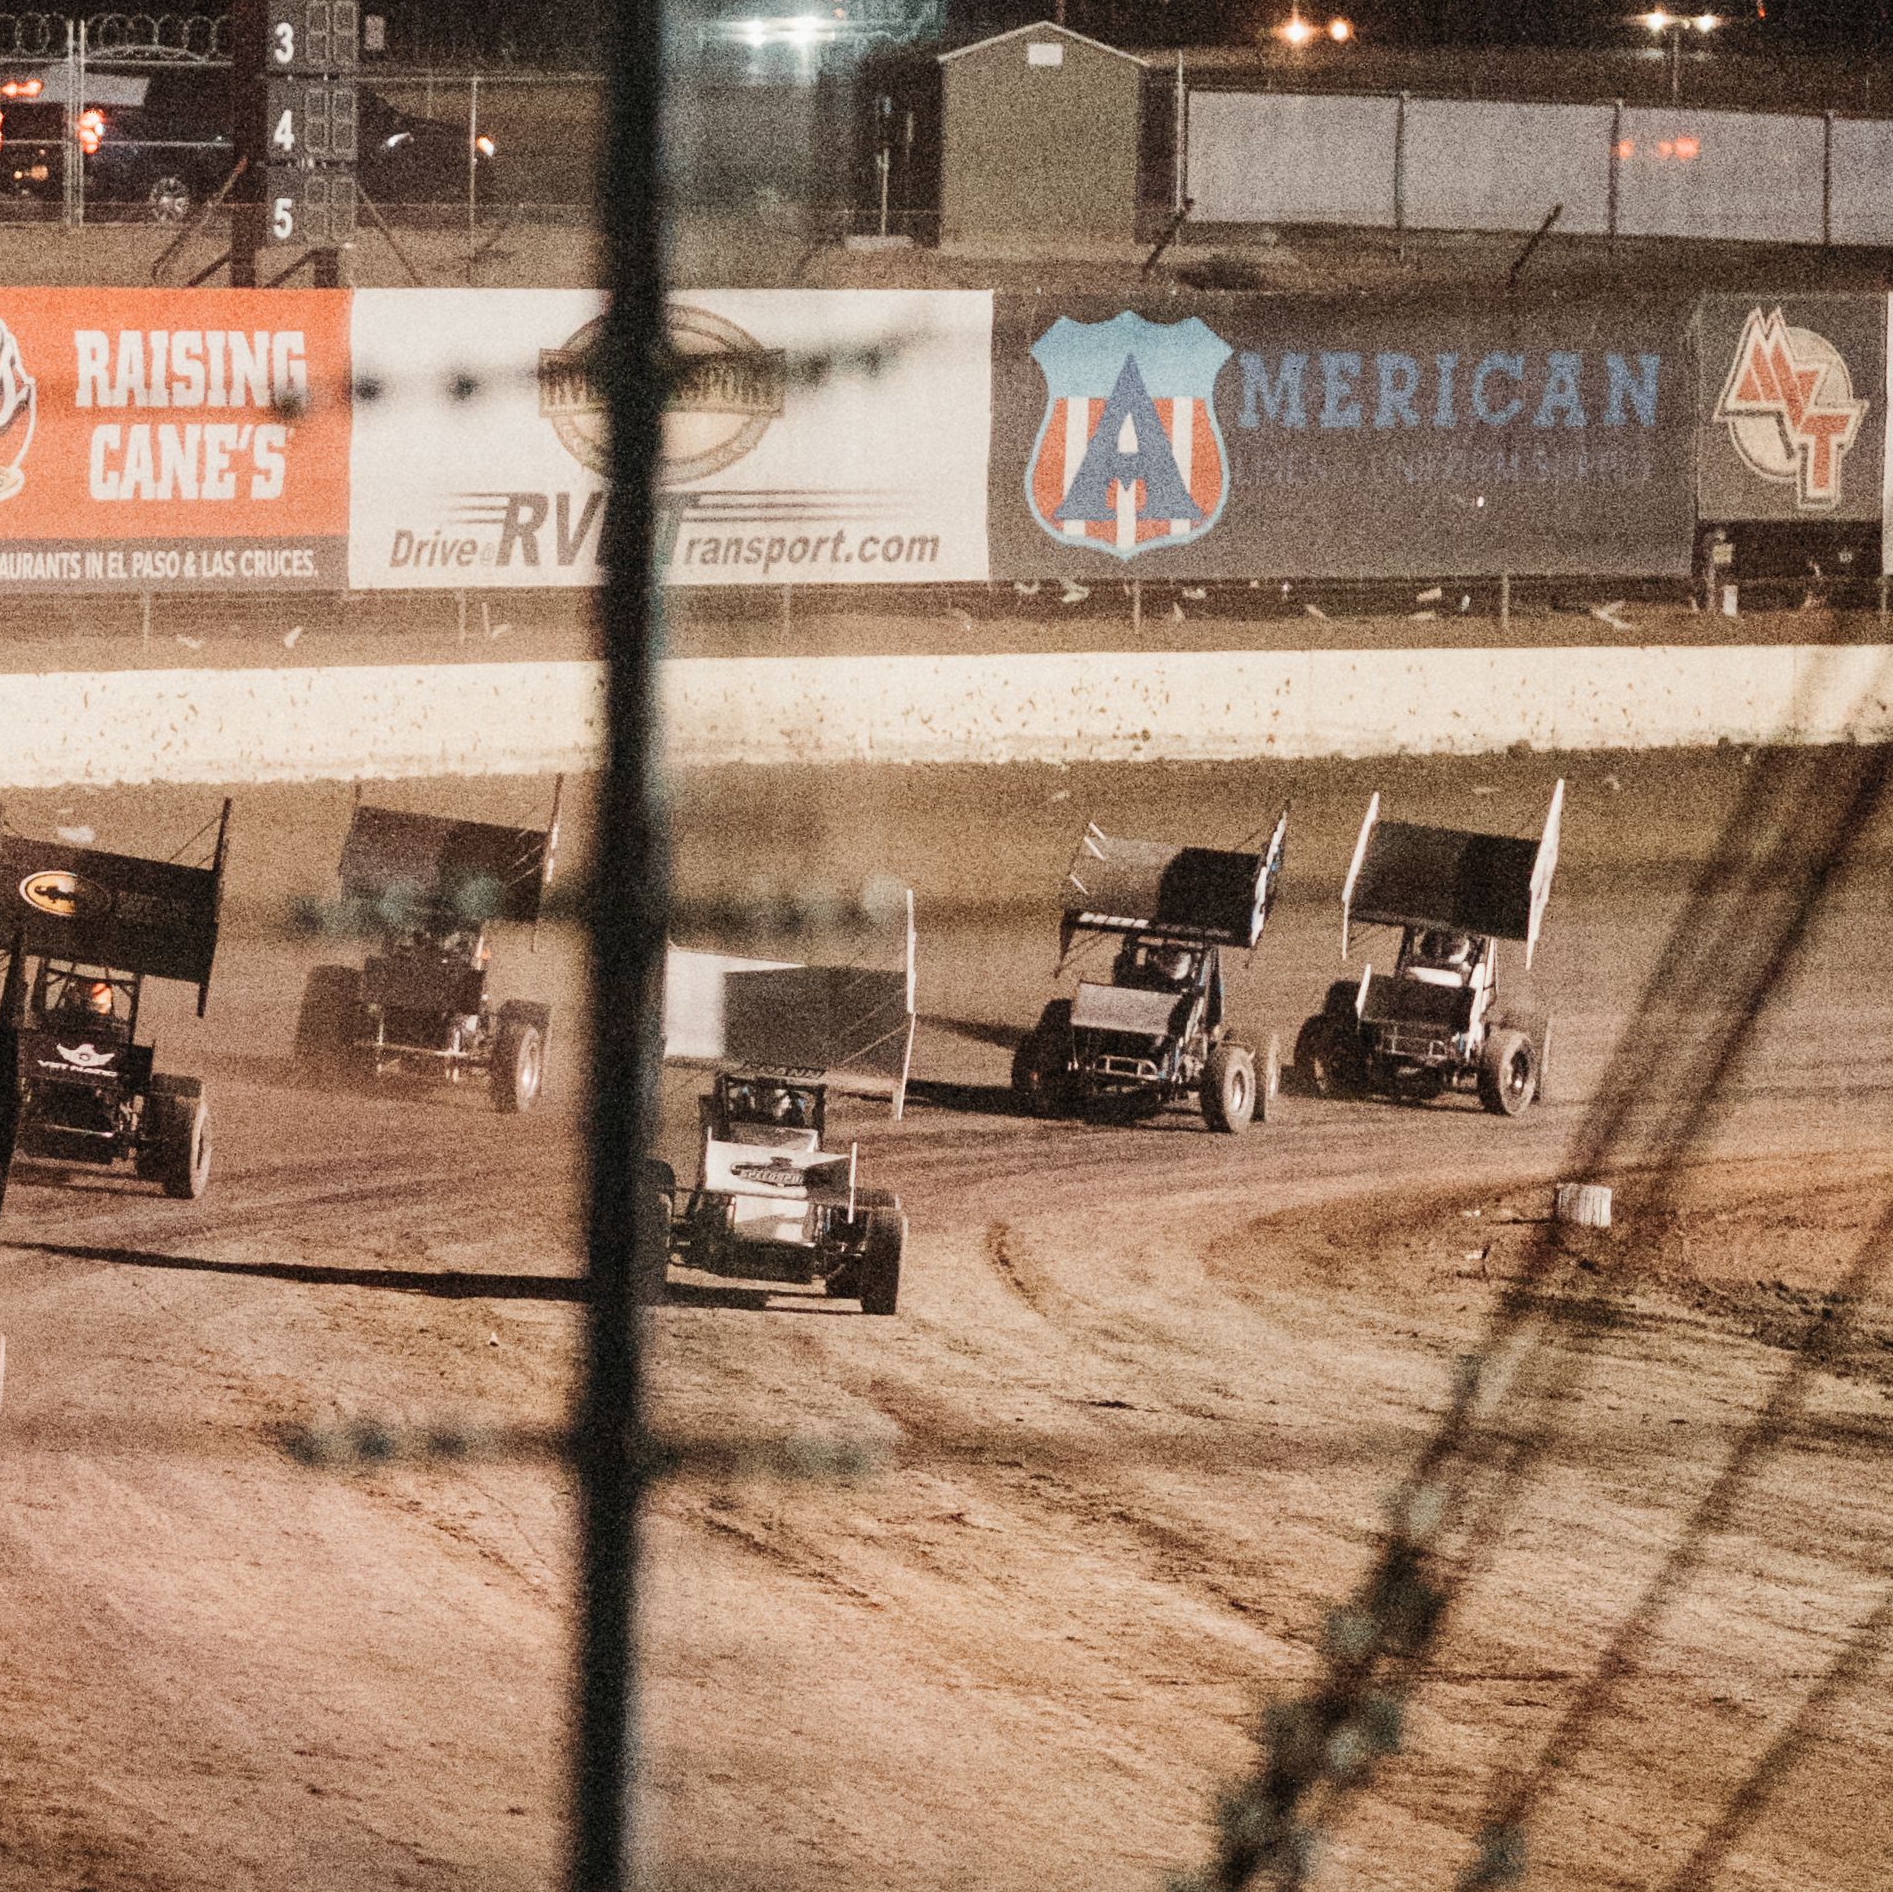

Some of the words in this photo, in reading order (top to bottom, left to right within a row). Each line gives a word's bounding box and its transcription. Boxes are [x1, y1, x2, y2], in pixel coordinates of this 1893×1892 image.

[274, 23, 293, 63] 3
[274, 110, 294, 150] 4
[274, 198, 292, 238] 5
[74, 329, 309, 409] RAISING
[89, 422, 288, 501] CANE'S
[85, 551, 104, 579] IN
[108, 551, 128, 579] EL
[132, 551, 180, 579] PASO
[183, 551, 197, 578] &
[202, 550, 236, 578] LAS
[240, 549, 320, 578] CRUCES.
